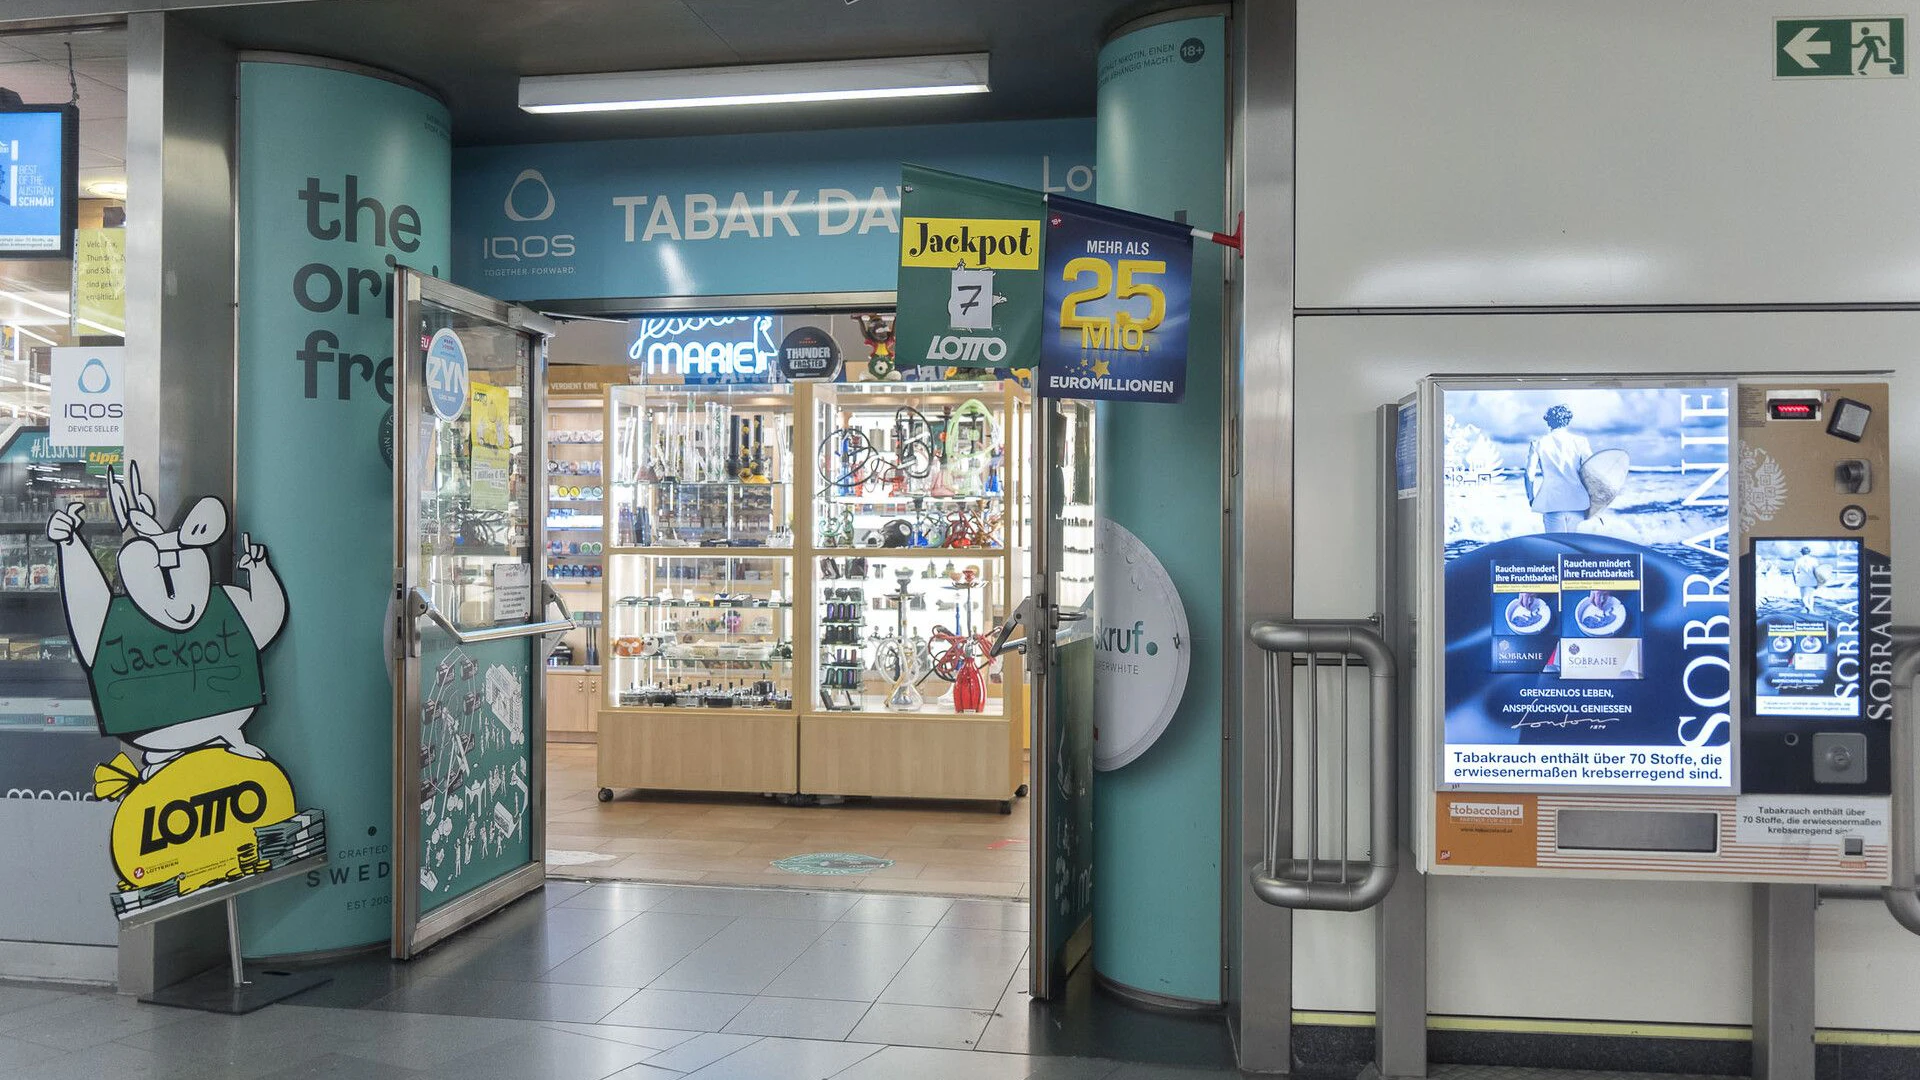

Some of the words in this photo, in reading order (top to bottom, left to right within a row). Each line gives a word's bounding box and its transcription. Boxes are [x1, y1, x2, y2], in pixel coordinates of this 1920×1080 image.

[1181, 45, 1205, 57] 18+
[19, 186, 54, 195] AUSTRIAN
[298, 174, 422, 253] the
[612, 189, 800, 242] TABAK
[818, 186, 901, 236] DA
[483, 234, 576, 261] IQOS
[909, 222, 1033, 266] Jackpot
[1086, 240, 1123, 254] MEHR
[1125, 241, 1150, 256] ALS
[531, 266, 577, 276] FORWARD.
[957, 285, 982, 316] 7
[1060, 257, 1167, 333] 25
[1081, 322, 1150, 352] MIO.
[786, 347, 831, 359] THUNDER
[926, 335, 1008, 362] LOTTO
[428, 356, 466, 394] ZYN
[1049, 375, 1174, 394] EUROMILLIONEN
[64, 403, 123, 420] IQOS
[68, 425, 93, 433] DEVICE
[94, 425, 120, 433] SELLER
[1495, 565, 1526, 573] Rauchen
[1527, 565, 1555, 573] mindert
[1563, 559, 1598, 568] Rauchen
[1599, 559, 1631, 568] mindert
[1677, 391, 1731, 750] SOBRANIE
[1495, 574, 1510, 582] Ihre
[1511, 574, 1558, 582] Fruchtbarkeit
[1563, 569, 1580, 578] Ihre
[1581, 569, 1634, 578] Fruchtbarkeit
[1867, 564, 1893, 720] SOBRANIE
[105, 618, 240, 692] Jackpot
[1498, 652, 1543, 660] SOBRANIE
[1568, 657, 1618, 665] SOBRANIE
[1519, 688, 1581, 697] GRENZENLOS
[1582, 688, 1614, 698] LEBEN,
[1502, 704, 1579, 713] ANSPRUCHSVOLL
[1580, 704, 1632, 713] GENIESSEN
[1453, 751, 1536, 764] Tabakrauch
[1540, 752, 1590, 765] enthält
[1593, 752, 1626, 765] über
[1629, 753, 1646, 765] 70
[1650, 753, 1698, 767] Stoffe,
[1700, 753, 1722, 766] die
[1453, 766, 1578, 778] erwiesenermaßen
[1582, 767, 1685, 780] krebserregend
[1688, 767, 1723, 780] sind.
[1454, 805, 1520, 816] tobaccoland
[1758, 806, 1811, 815] Tabakrauch
[1812, 807, 1843, 816] enthält
[1845, 807, 1866, 817] über
[139, 780, 268, 857] LOTTO
[1742, 815, 1753, 824] 70
[1755, 815, 1785, 825] Stoffe,
[1786, 817, 1800, 825] die
[1802, 817, 1882, 827] erwiesenermaßen
[1767, 826, 1832, 836] krebserregend
[338, 844, 389, 860] CRAFTED
[306, 861, 391, 888] SWED
[346, 899, 367, 911] EST
